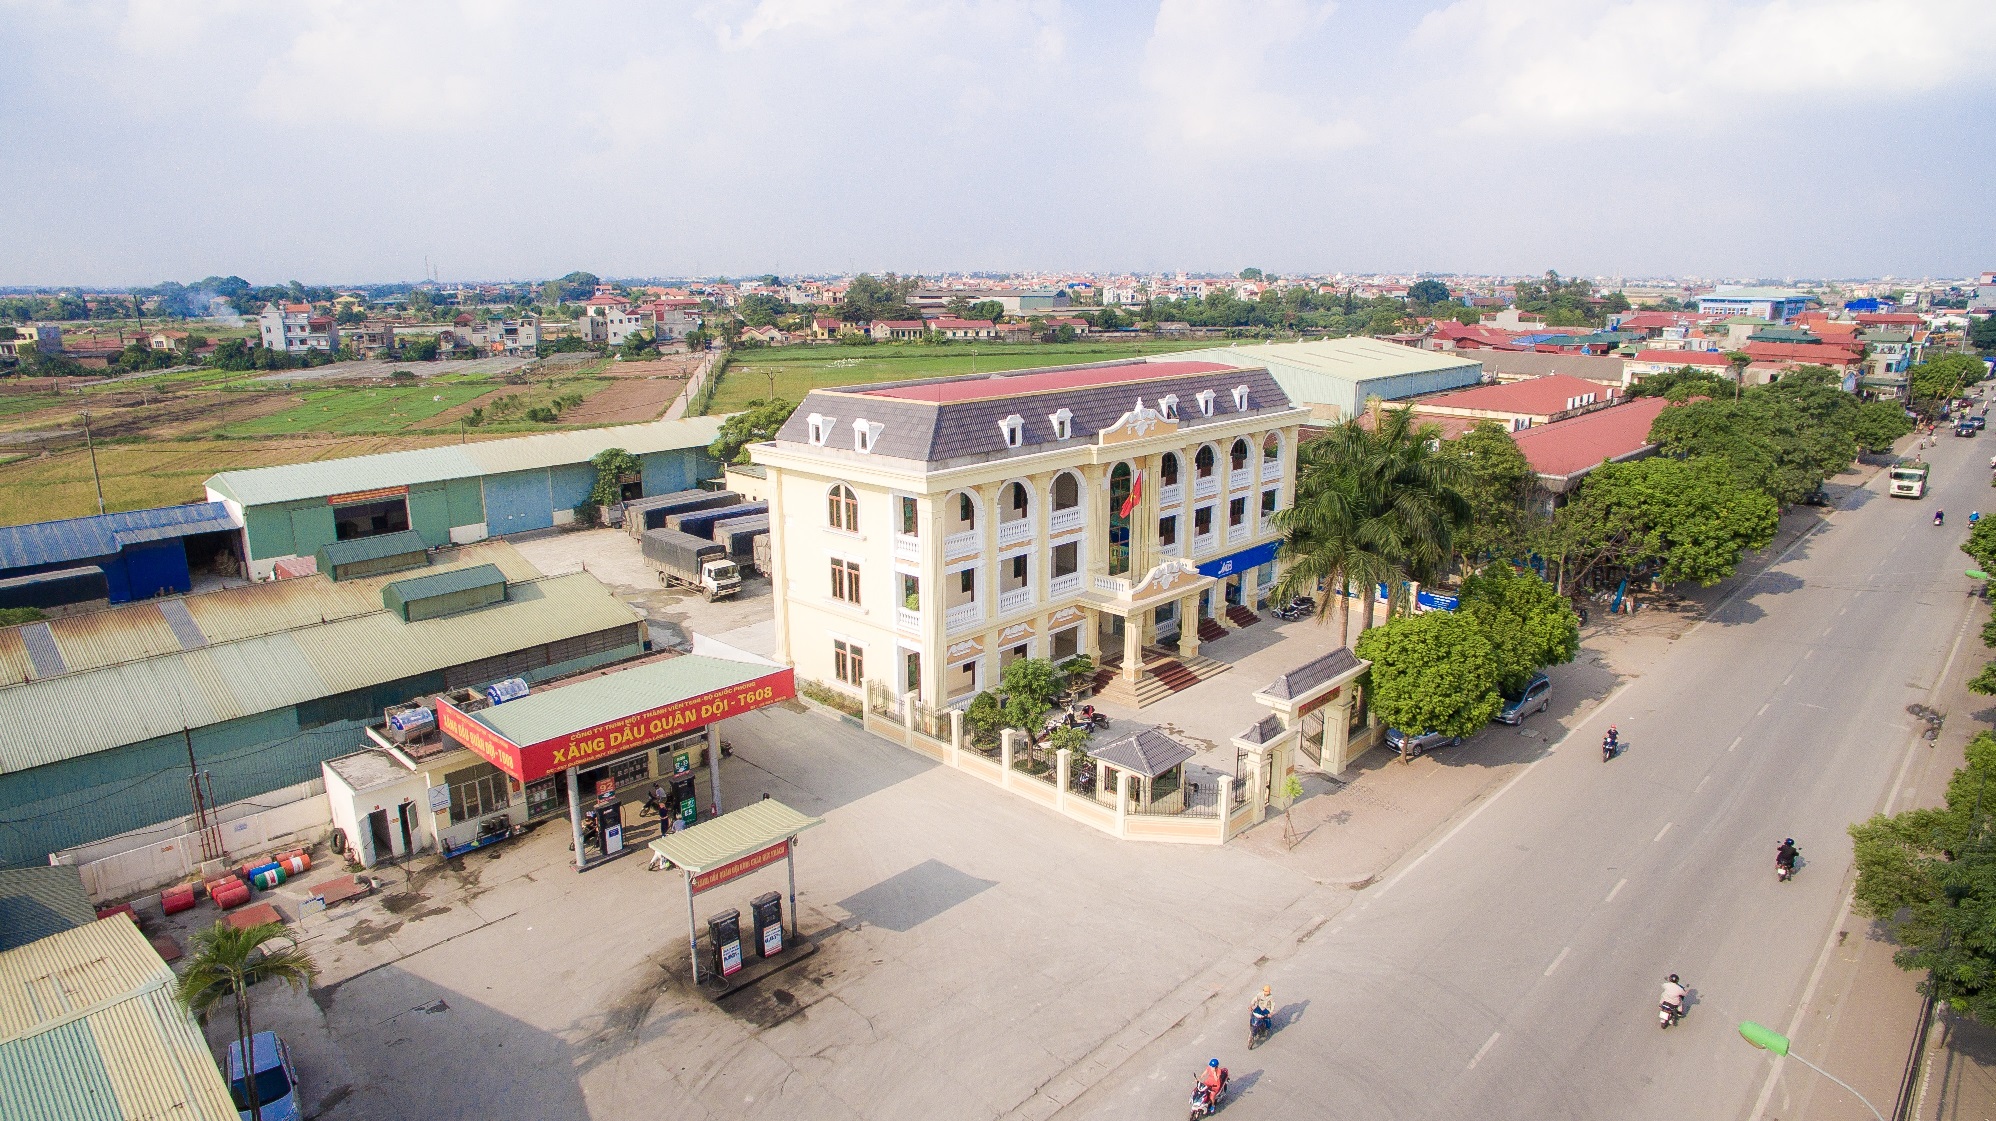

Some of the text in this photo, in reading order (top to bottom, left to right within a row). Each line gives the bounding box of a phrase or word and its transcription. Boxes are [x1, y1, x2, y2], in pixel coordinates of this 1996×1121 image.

[552, 737, 605, 764] XĂNG
[609, 723, 645, 747] DẦU
[649, 708, 697, 734] QUÂN
[700, 698, 728, 718] ĐỘI
[738, 686, 772, 706] T608
[570, 729, 592, 741] CÔNG
[605, 721, 624, 730] TNHH
[643, 708, 667, 719] THÀNH
[668, 702, 683, 711] VIÊN
[713, 687, 732, 698] QUỐC
[733, 681, 756, 692] PHÒNG
[600, 782, 613, 791] 92
